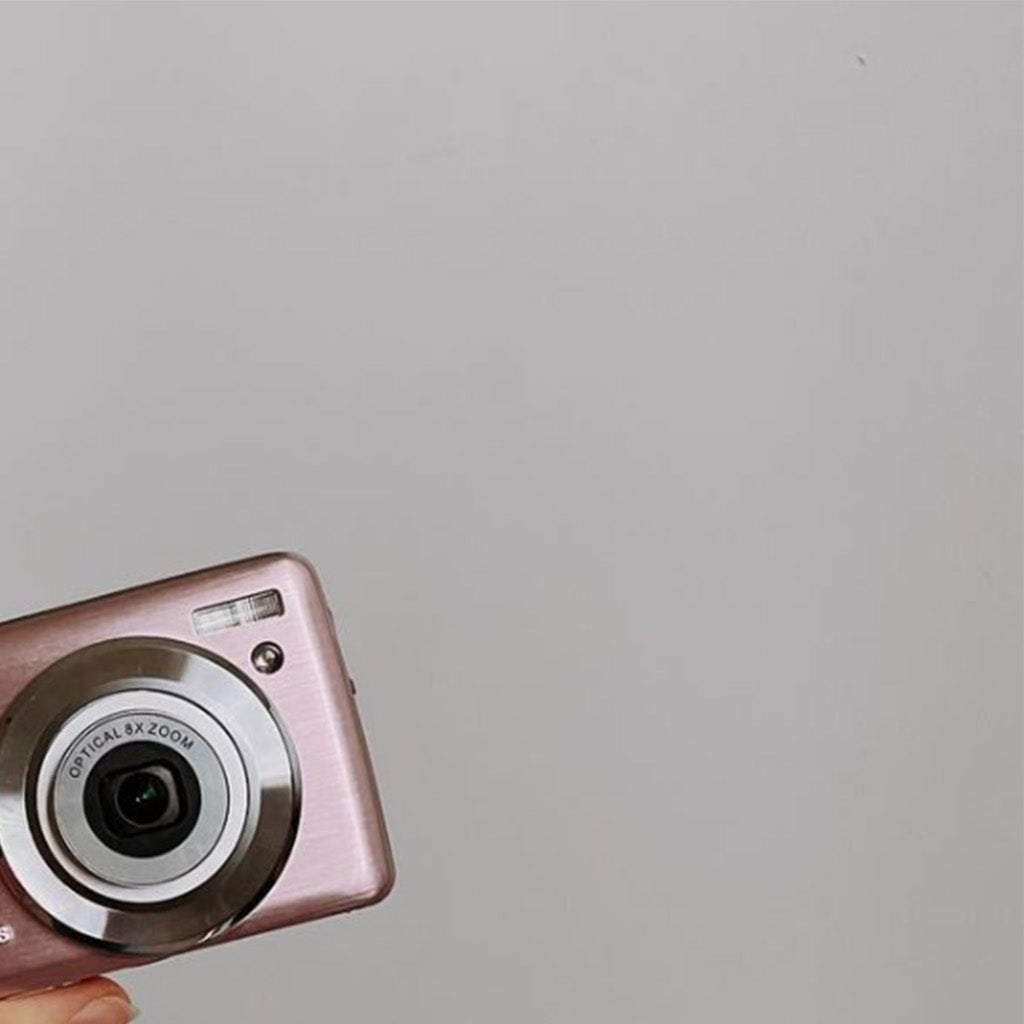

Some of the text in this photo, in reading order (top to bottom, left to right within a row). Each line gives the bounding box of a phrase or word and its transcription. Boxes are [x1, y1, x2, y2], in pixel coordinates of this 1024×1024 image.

[68, 722, 195, 779] OPTICAL 8X ZOOM
